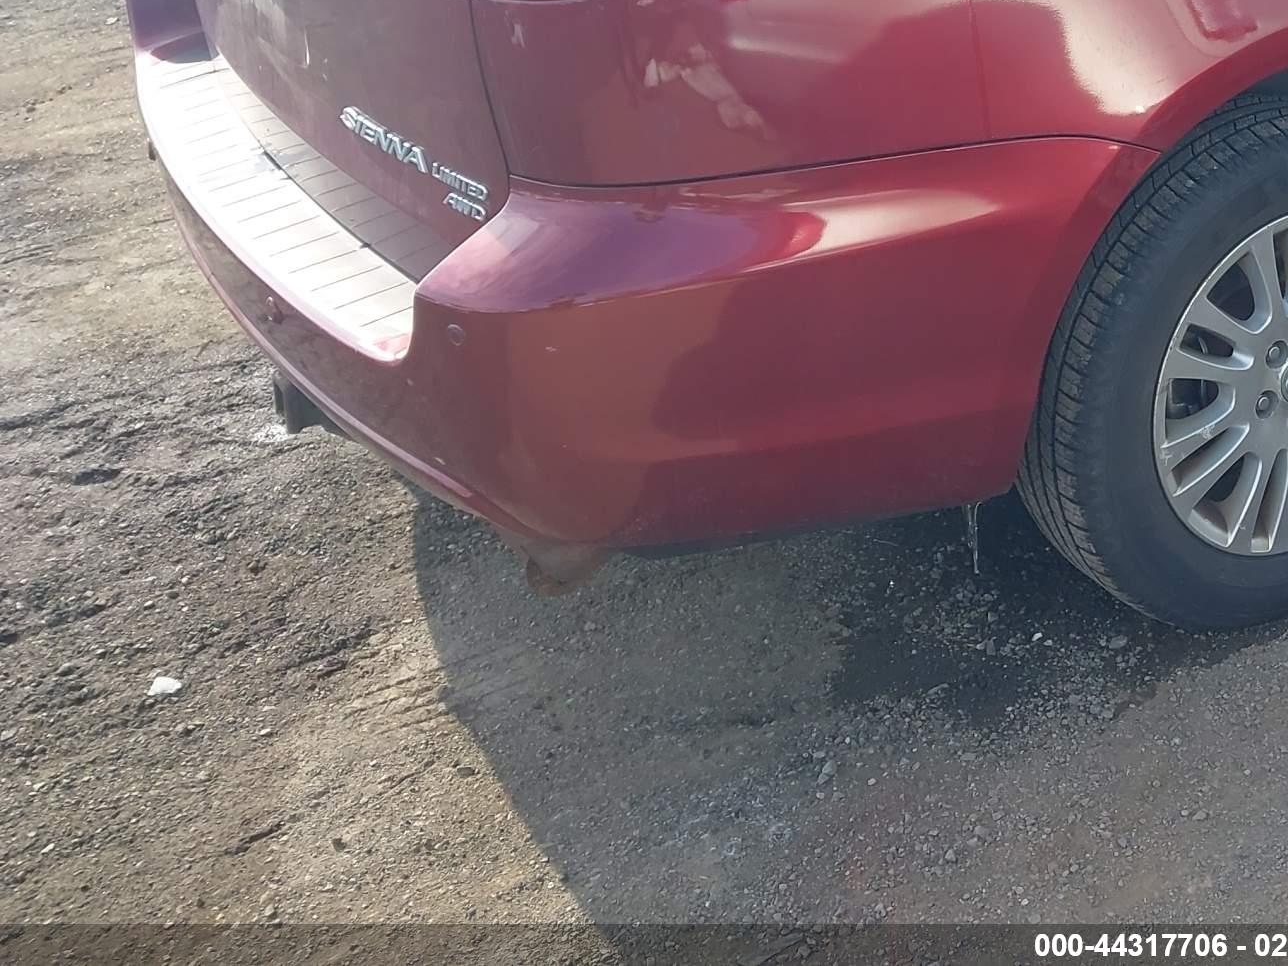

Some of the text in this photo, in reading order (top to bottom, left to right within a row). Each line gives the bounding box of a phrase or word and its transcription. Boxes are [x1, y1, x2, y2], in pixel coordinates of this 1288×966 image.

[340, 106, 488, 201] SIENNA LIMITED
[443, 192, 486, 221] AWD
